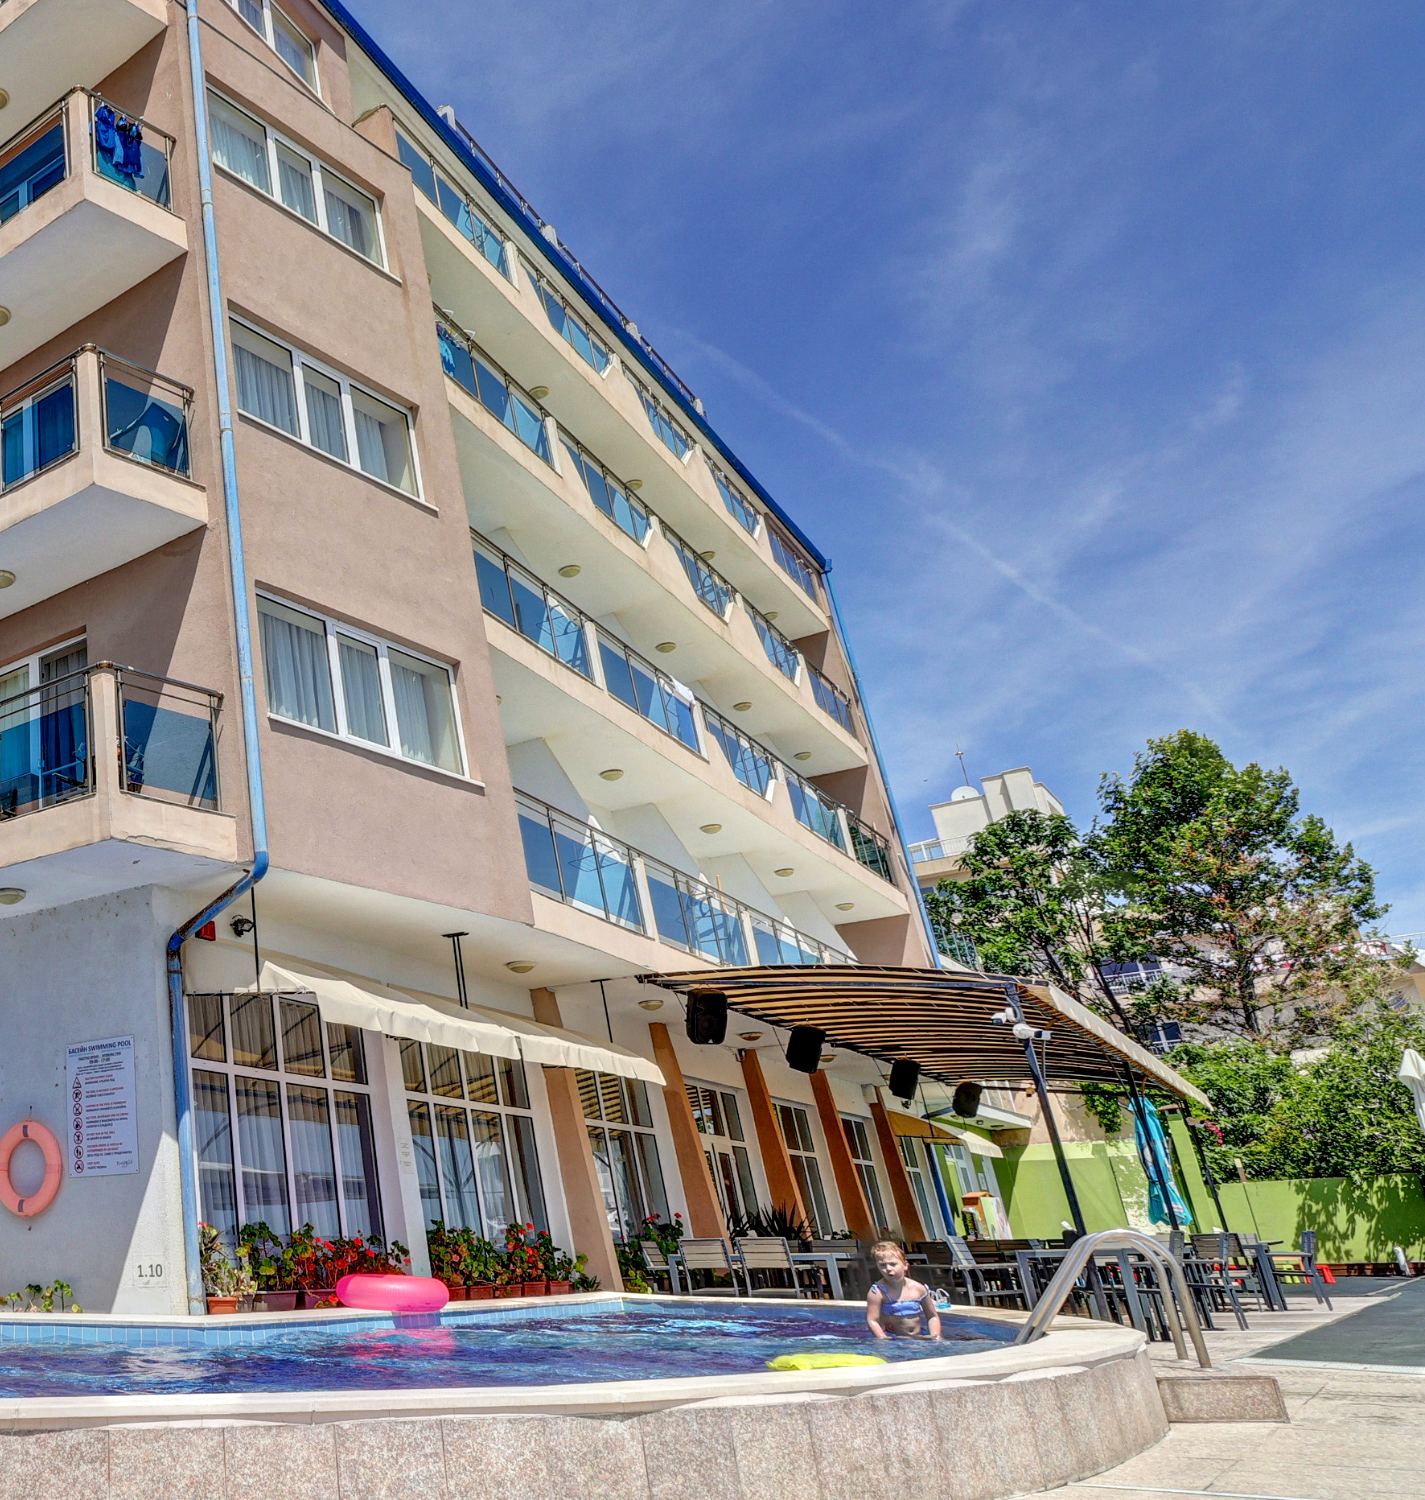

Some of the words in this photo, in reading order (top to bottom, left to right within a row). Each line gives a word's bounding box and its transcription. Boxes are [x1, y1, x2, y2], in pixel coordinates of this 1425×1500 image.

[68, 1046, 87, 1054] БАСЕЙН
[88, 1042, 116, 1051] SWIMMING
[137, 1263, 163, 1278] 1.10
